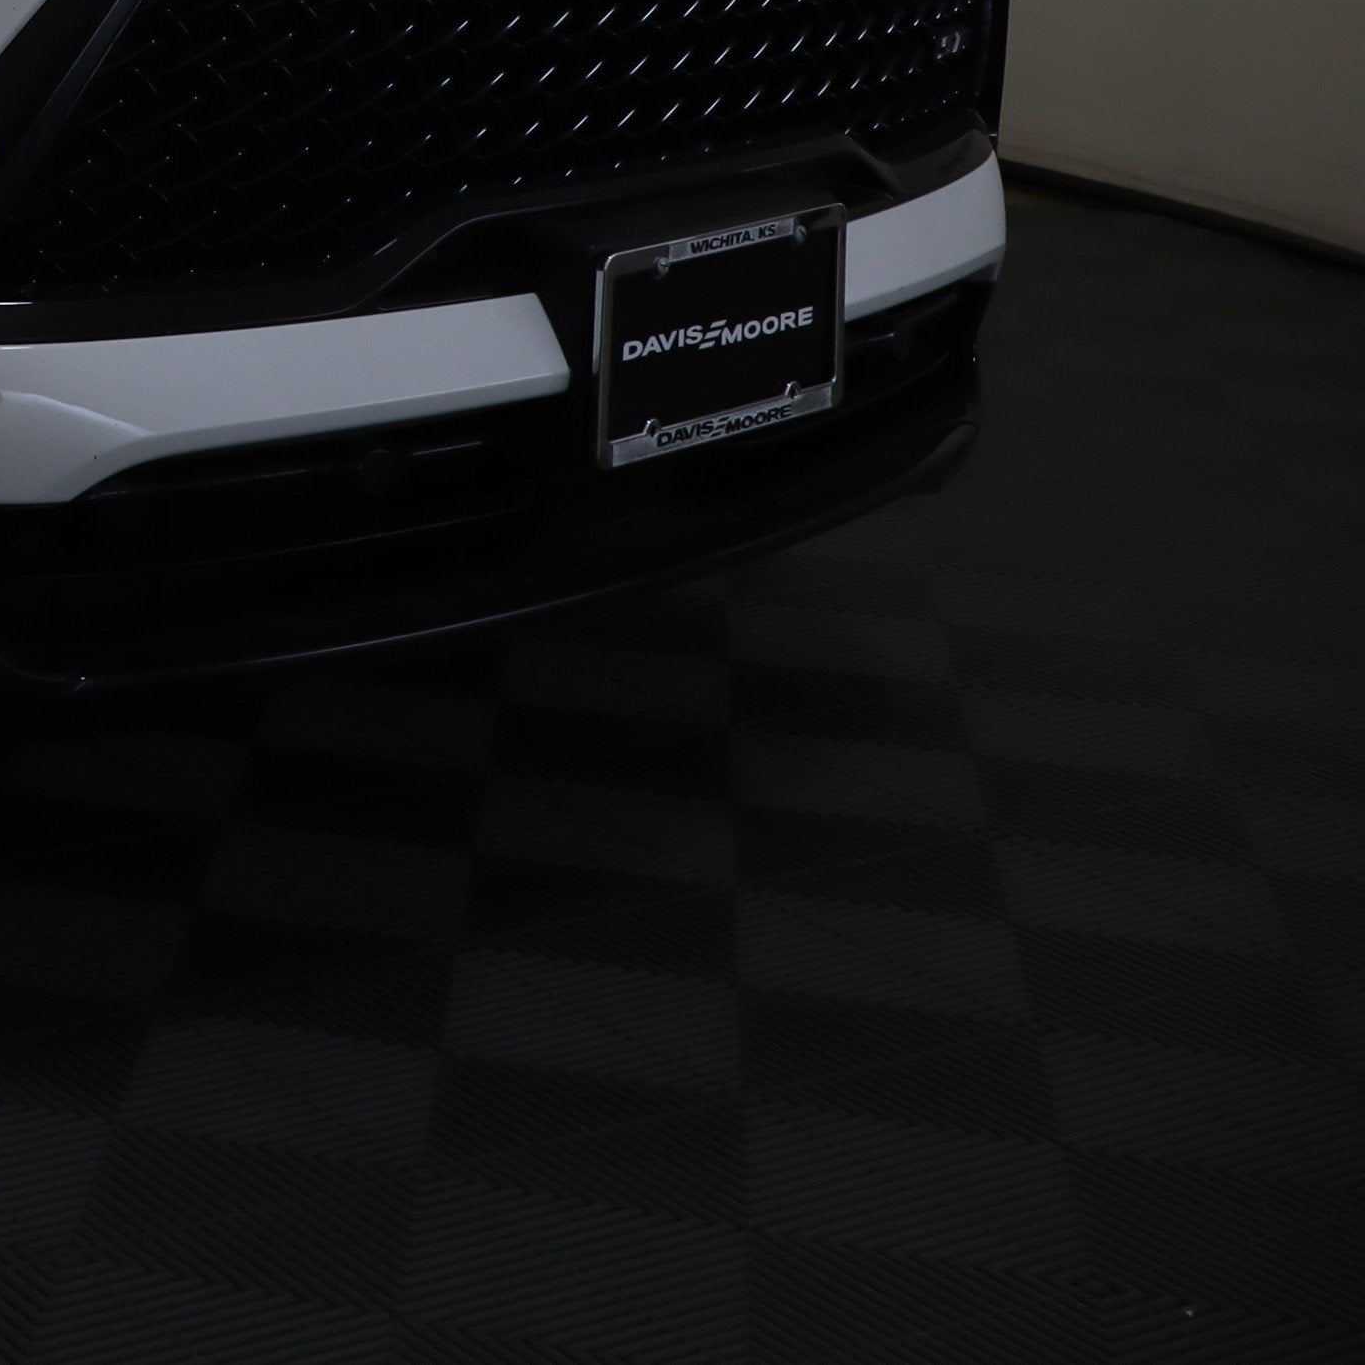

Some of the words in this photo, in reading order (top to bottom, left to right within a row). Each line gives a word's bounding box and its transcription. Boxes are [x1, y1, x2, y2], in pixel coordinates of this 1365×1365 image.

[758, 224, 776, 239] KS
[622, 325, 704, 362] DAVIS
[720, 306, 814, 346] MOORE
[657, 421, 715, 447] DAVIS
[724, 404, 792, 435] MOORE
